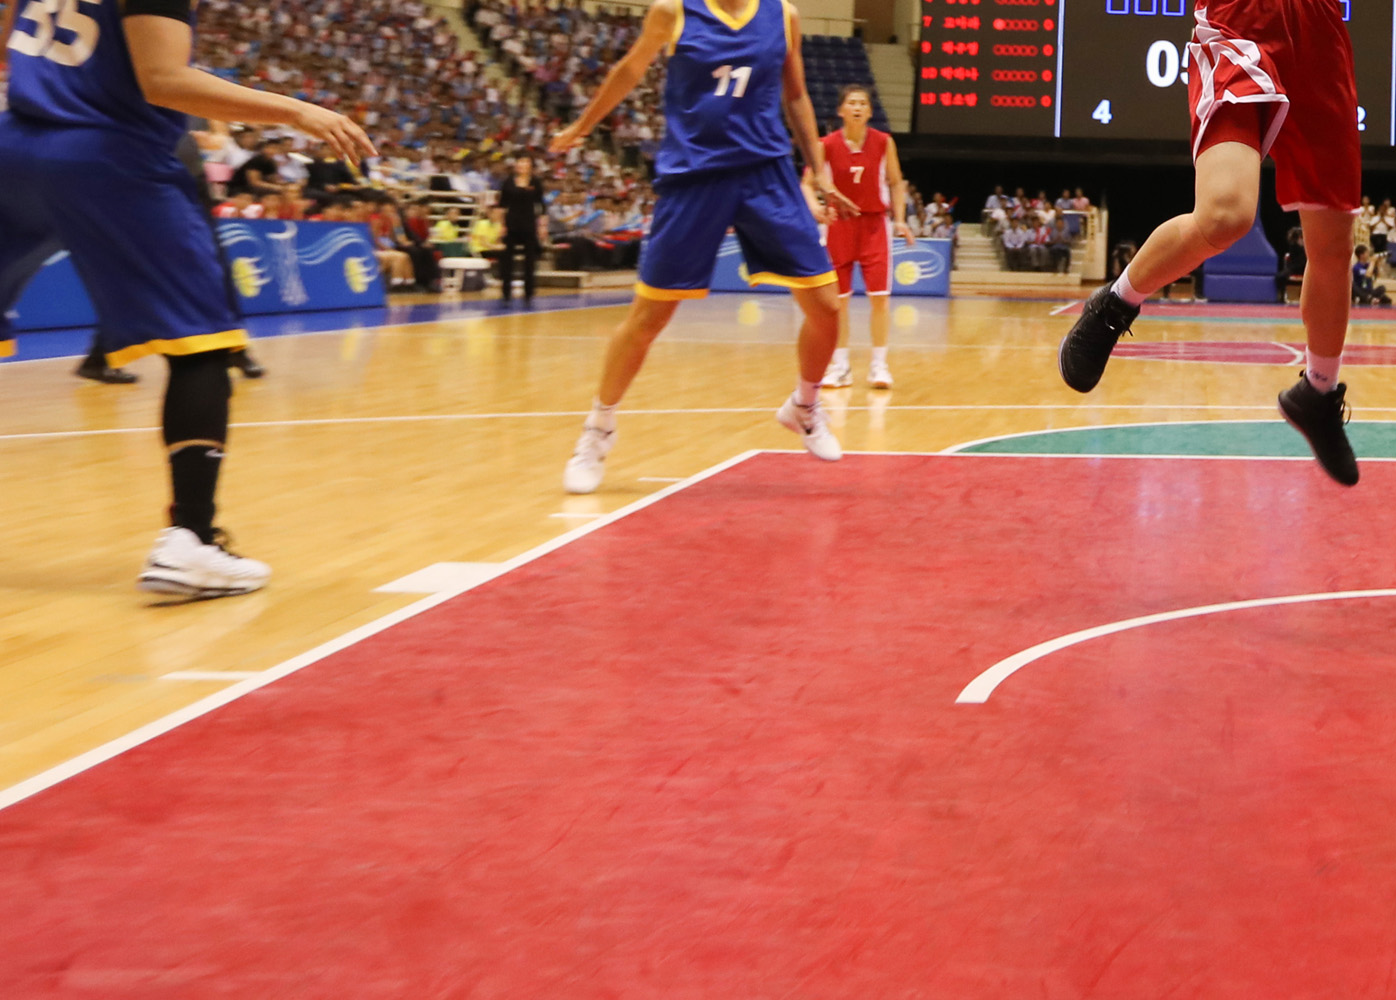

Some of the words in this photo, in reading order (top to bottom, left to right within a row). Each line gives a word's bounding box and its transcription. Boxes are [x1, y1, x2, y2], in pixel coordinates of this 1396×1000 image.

[711, 64, 753, 99] 11
[1091, 99, 1113, 125] 4
[848, 165, 866, 185] 7
